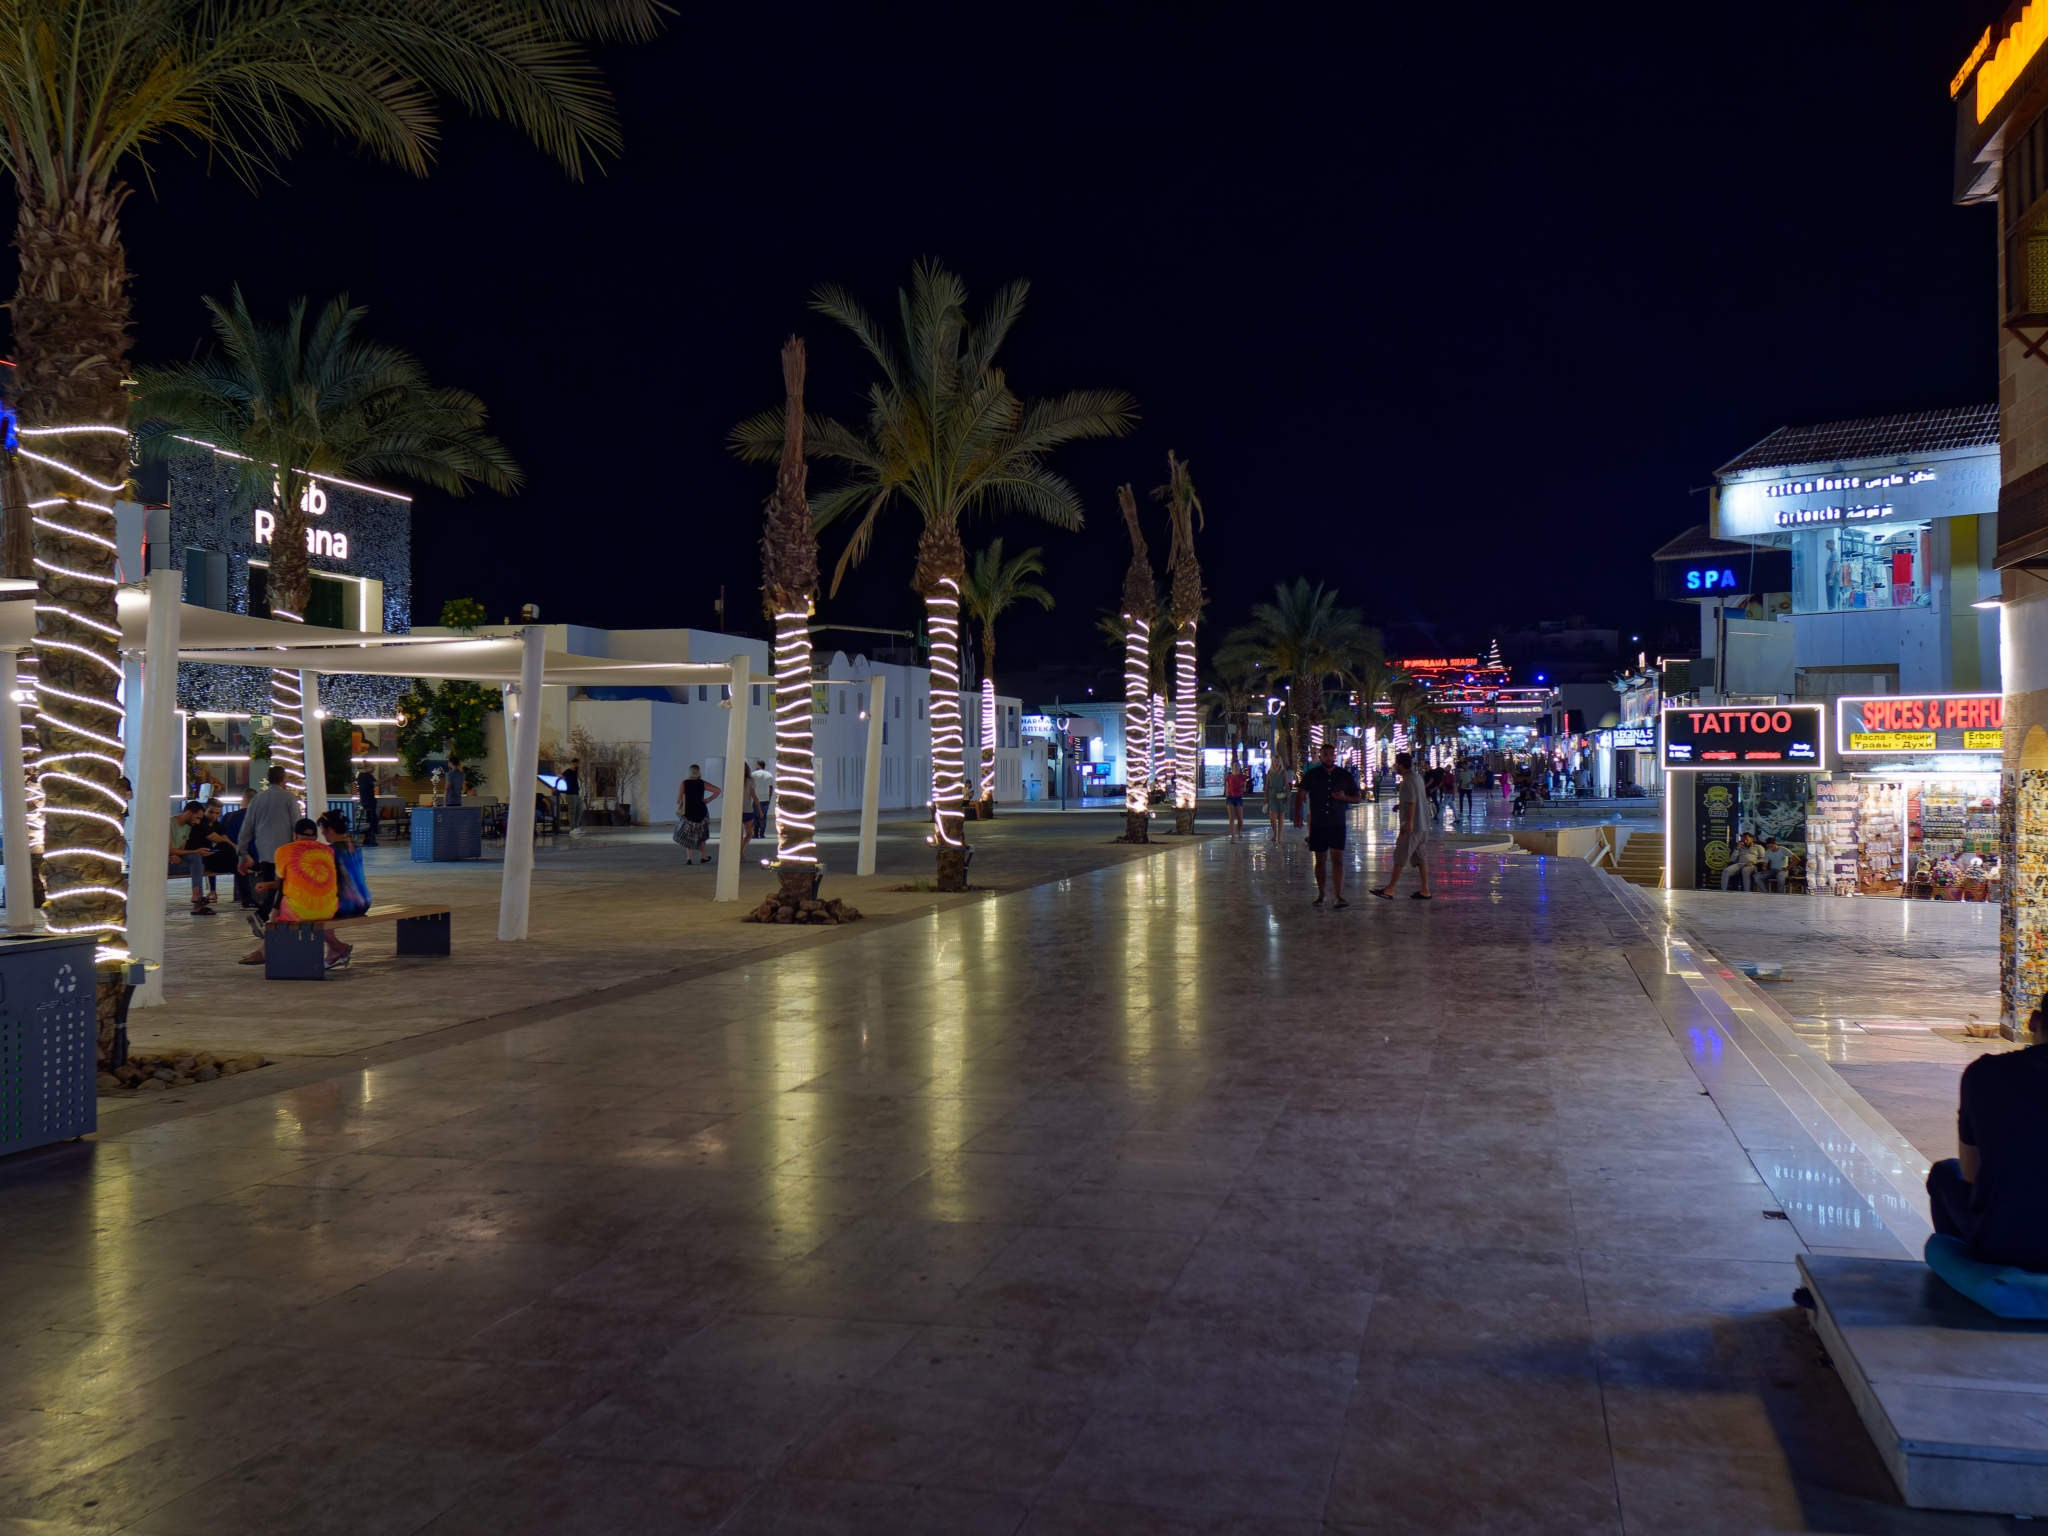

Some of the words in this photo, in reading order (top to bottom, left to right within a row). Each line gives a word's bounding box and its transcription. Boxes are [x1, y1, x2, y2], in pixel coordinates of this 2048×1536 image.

[1817, 478, 1859, 491] House
[1774, 506, 1839, 524] Karkoucha
[255, 510, 348, 559] Rana
[1686, 570, 1737, 589] SPA
[1688, 711, 1792, 734] TATTOO
[1863, 700, 1925, 730] SPICES
[1927, 699, 1943, 729] &
[1902, 741, 1932, 749] Духи
